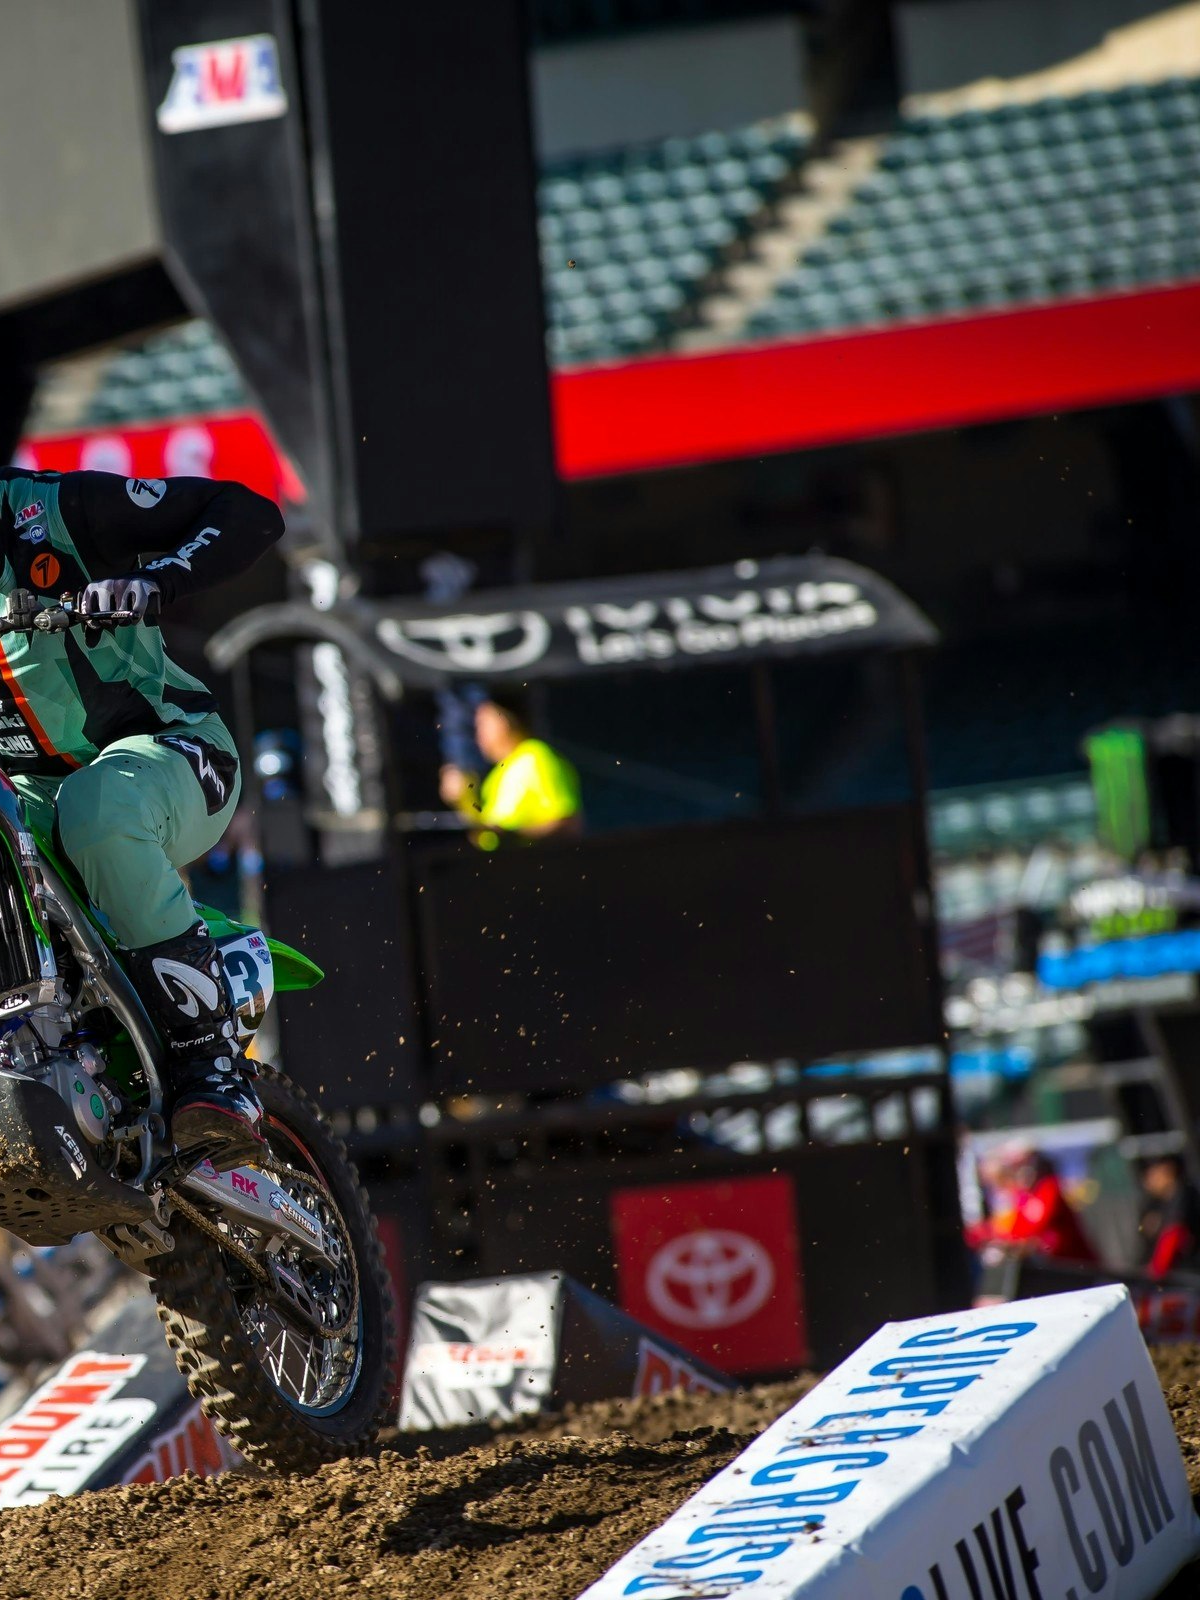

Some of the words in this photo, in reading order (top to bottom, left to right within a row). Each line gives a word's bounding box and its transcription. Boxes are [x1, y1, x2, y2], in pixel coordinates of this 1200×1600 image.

[15, 501, 45, 527] AMA
[31, 528, 45, 538] FIM
[36, 555, 50, 587] 7
[223, 950, 266, 1031] 3
[170, 1033, 215, 1049] forma
[231, 1171, 260, 1199] RK
[14, 1413, 132, 1498] TIRE
[622, 1321, 1038, 1600] SUPERCROSS
